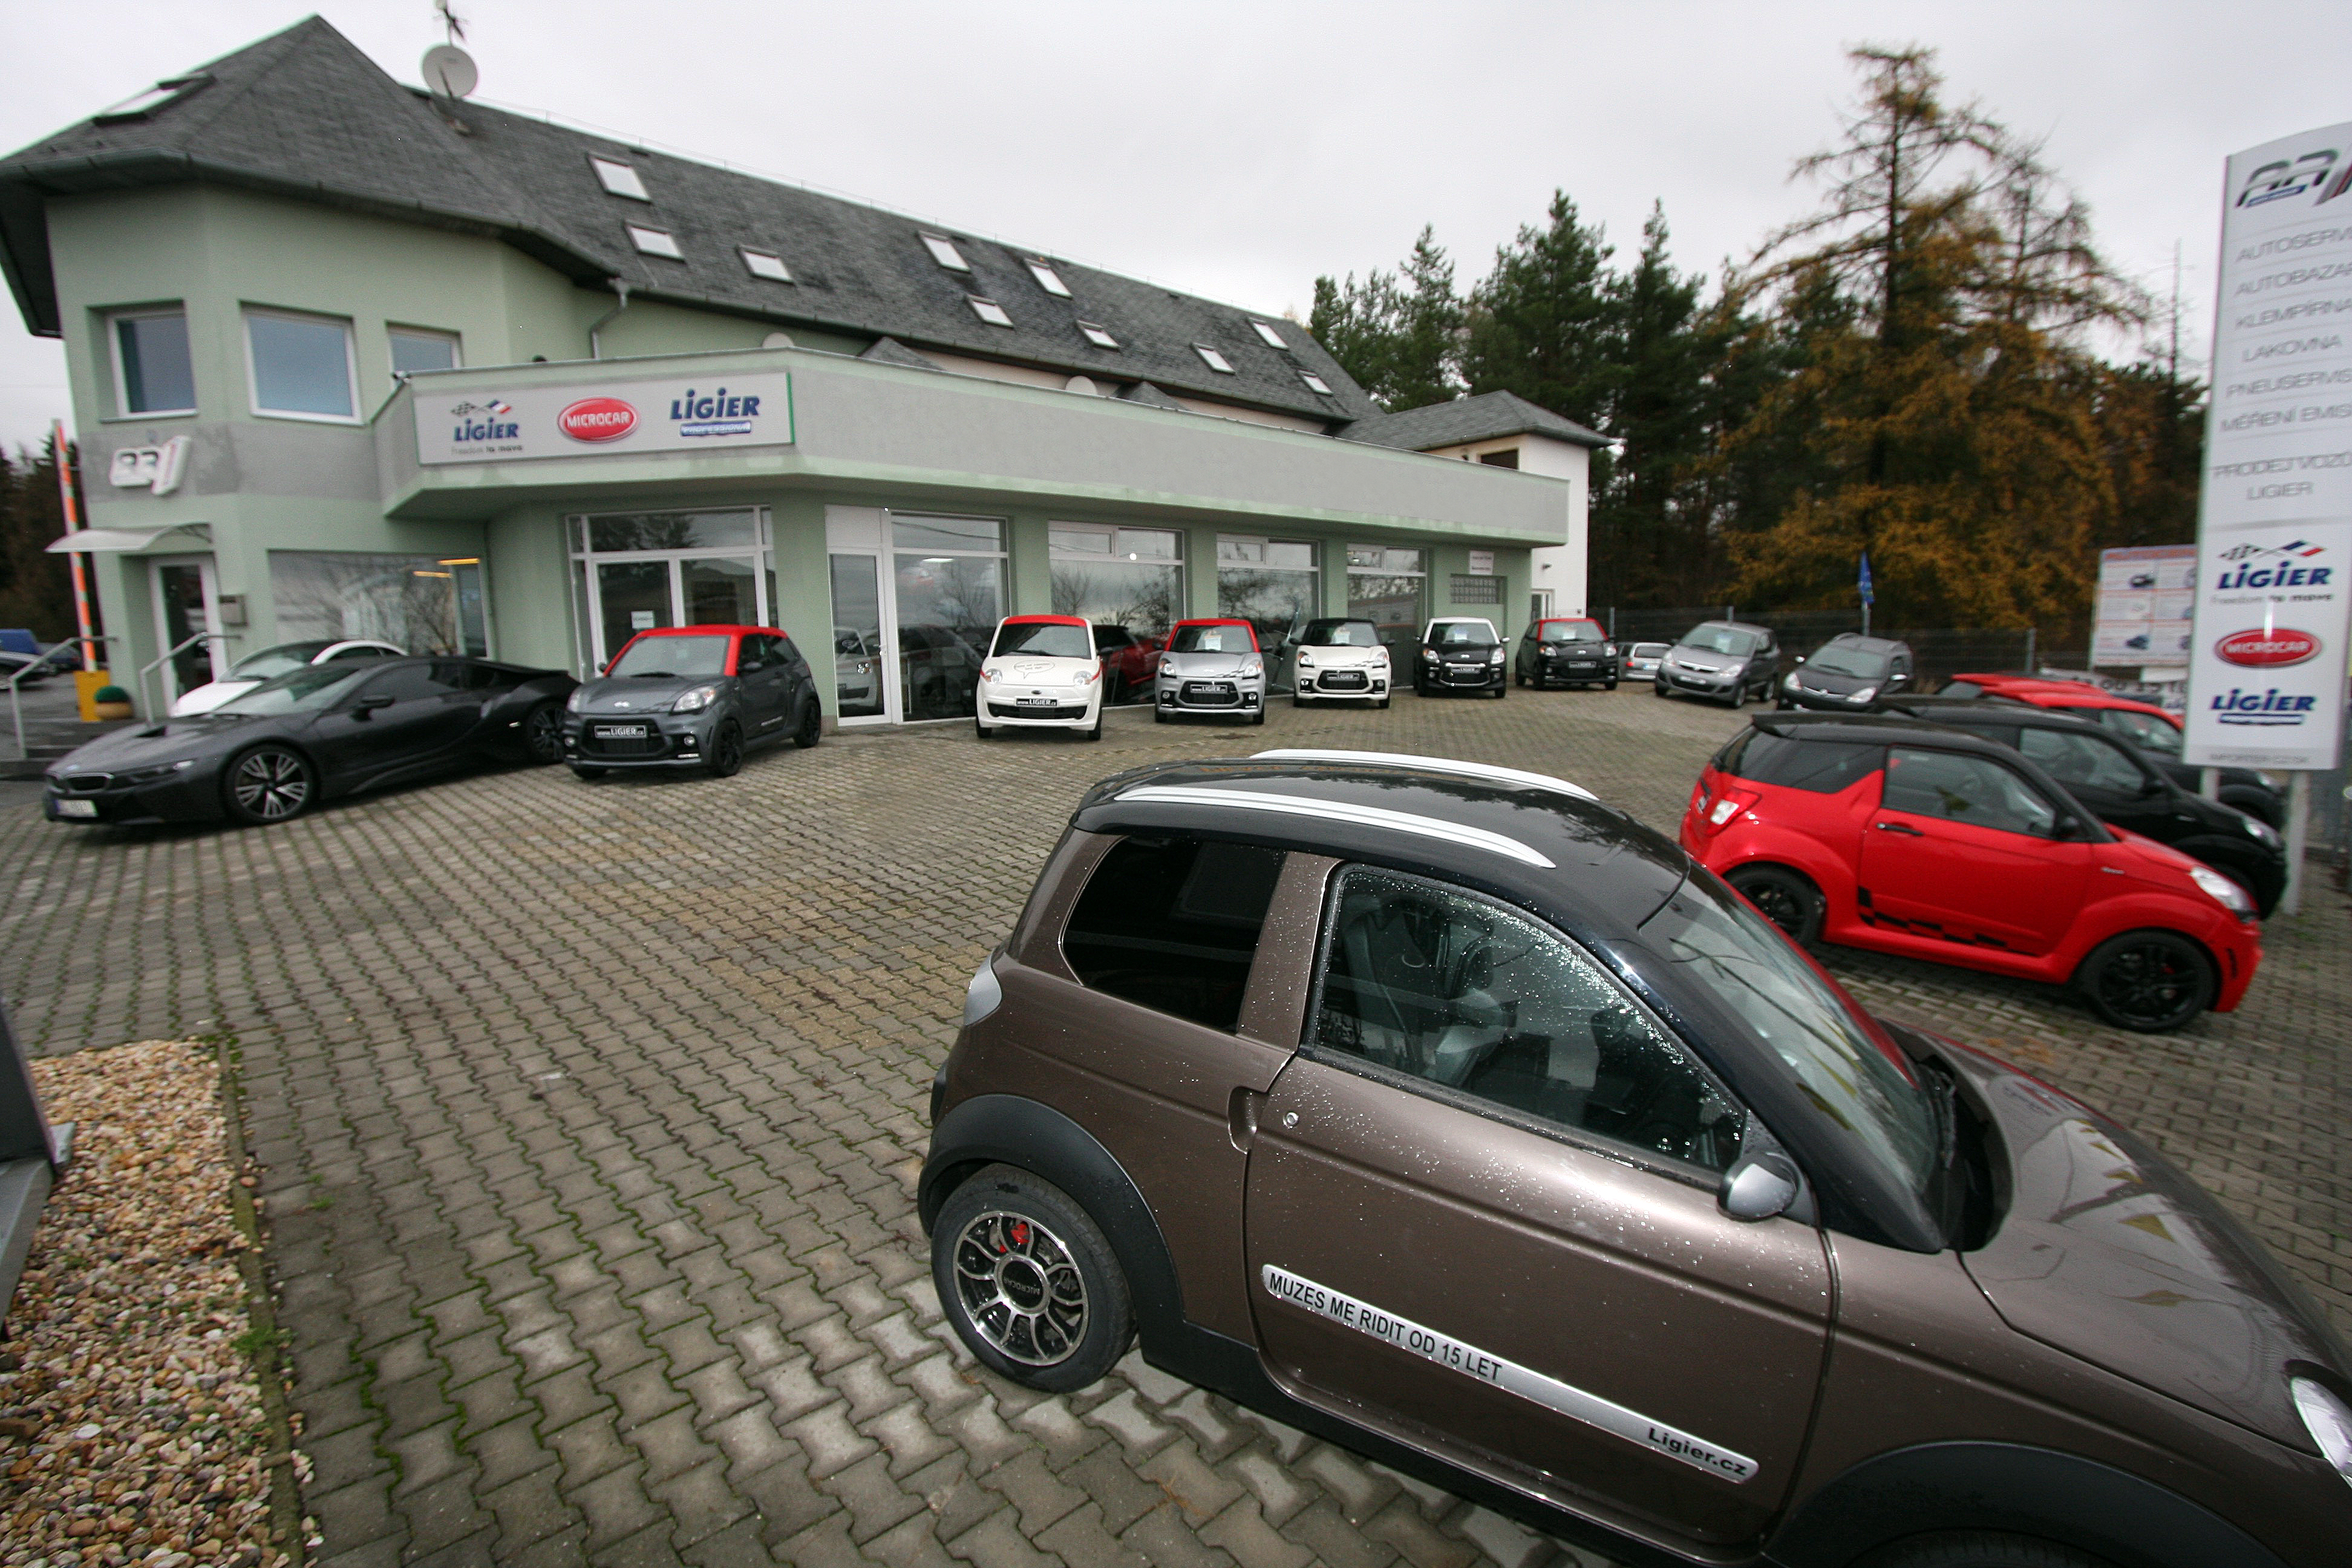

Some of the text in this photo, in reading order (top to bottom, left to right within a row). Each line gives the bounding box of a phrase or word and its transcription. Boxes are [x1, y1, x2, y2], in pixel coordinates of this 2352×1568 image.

[566, 411, 630, 428] MICROCAR
[1270, 1272, 1748, 1477] MUZES ME RIDIT OD 15 LET Ligier.cz
